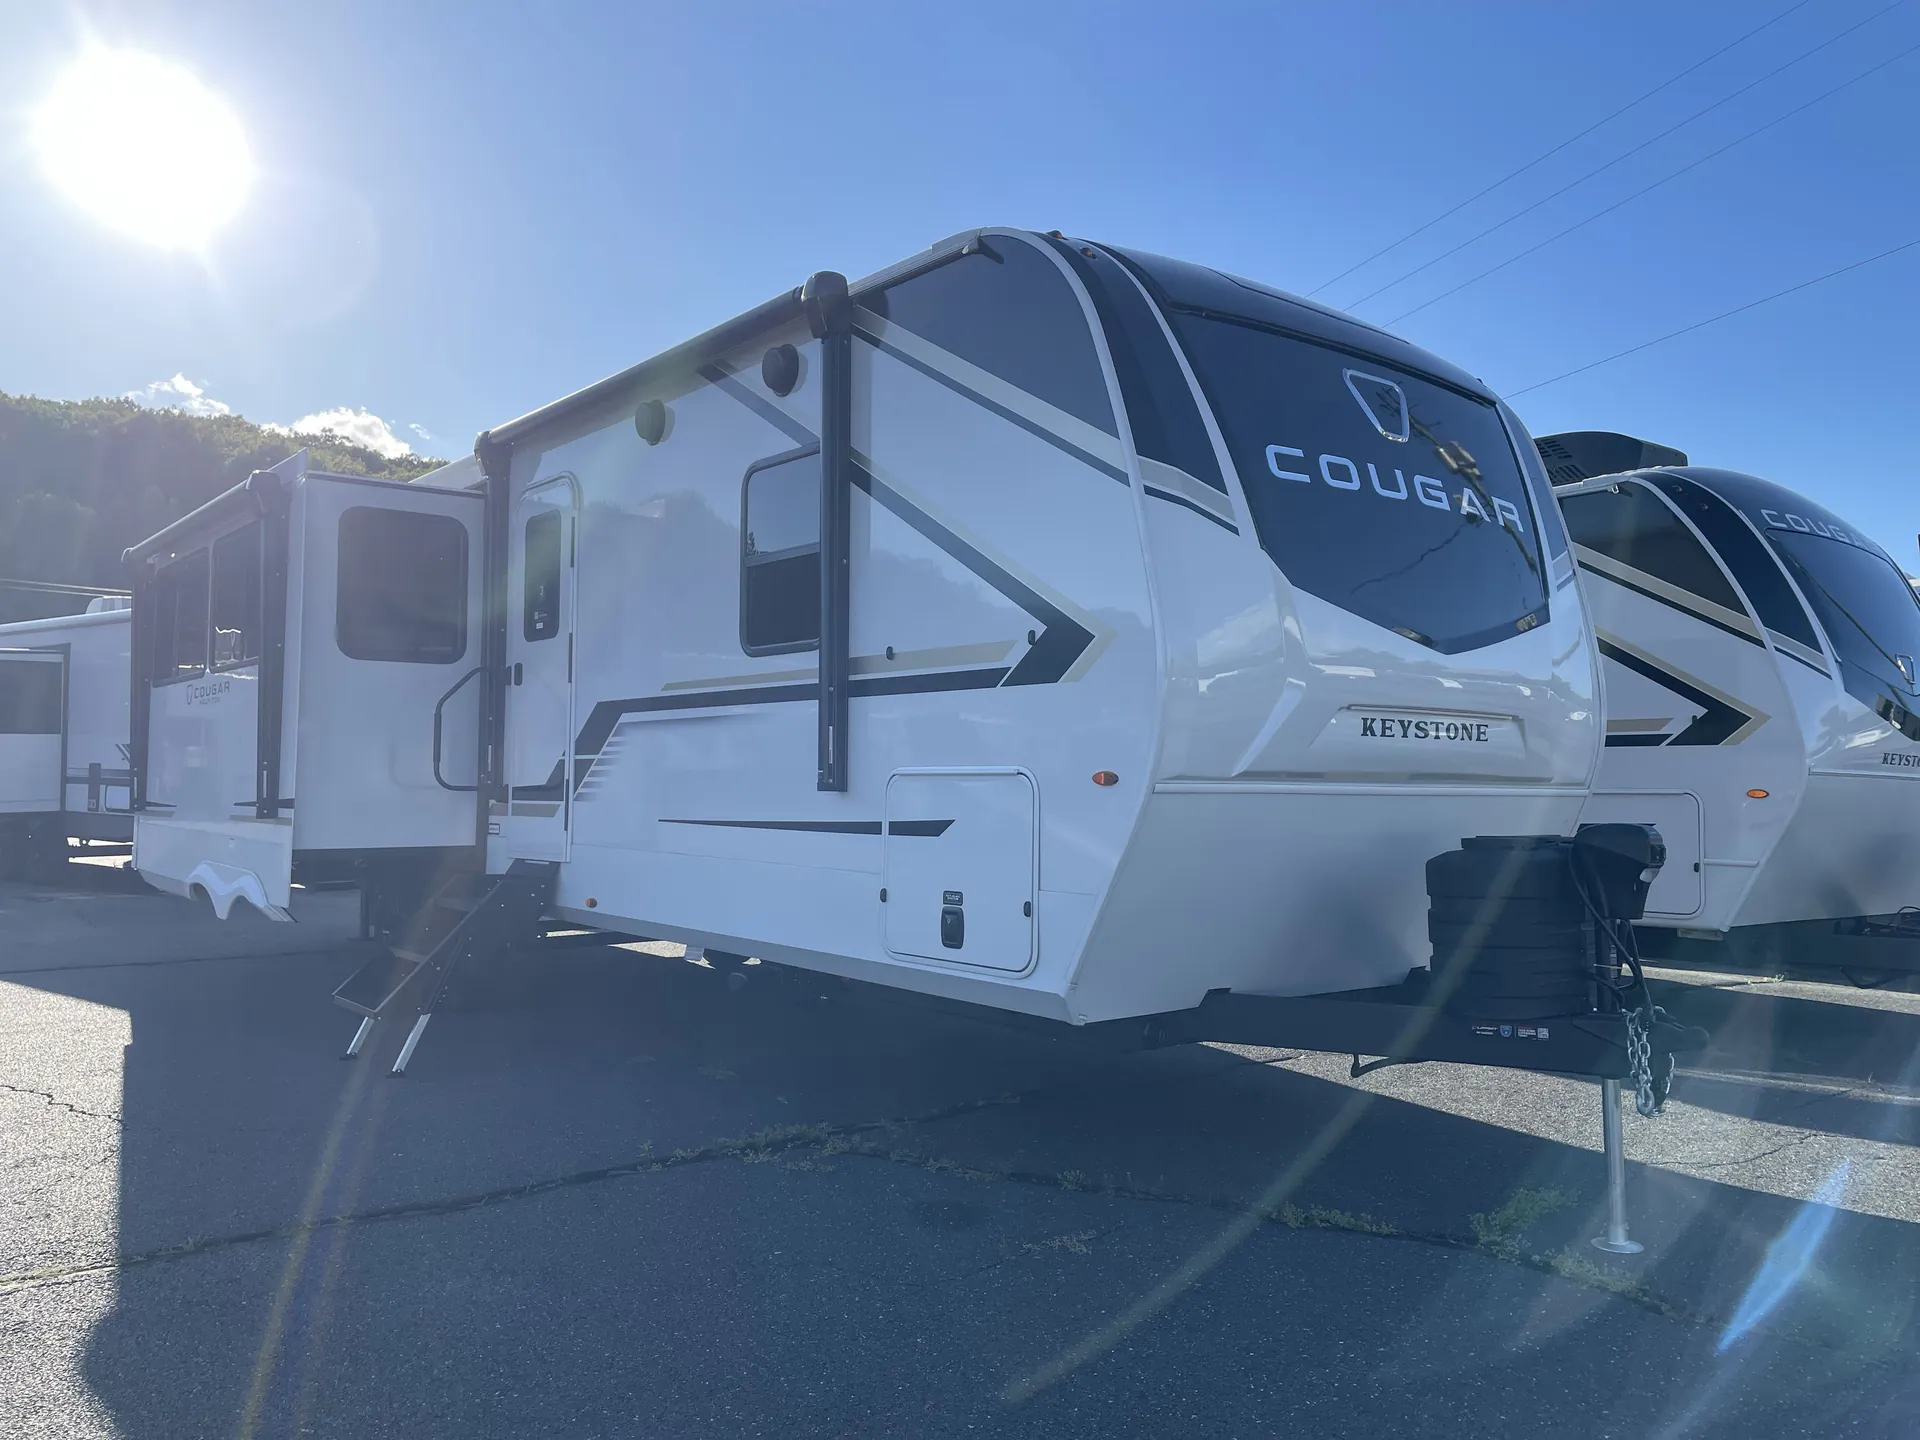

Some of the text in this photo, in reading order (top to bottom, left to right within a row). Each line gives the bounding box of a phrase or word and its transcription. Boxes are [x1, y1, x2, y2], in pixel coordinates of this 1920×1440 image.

[1265, 444, 1524, 532] COUGAR
[194, 681, 230, 699] COUGAR
[1361, 717, 1489, 742] KEYSTONE
